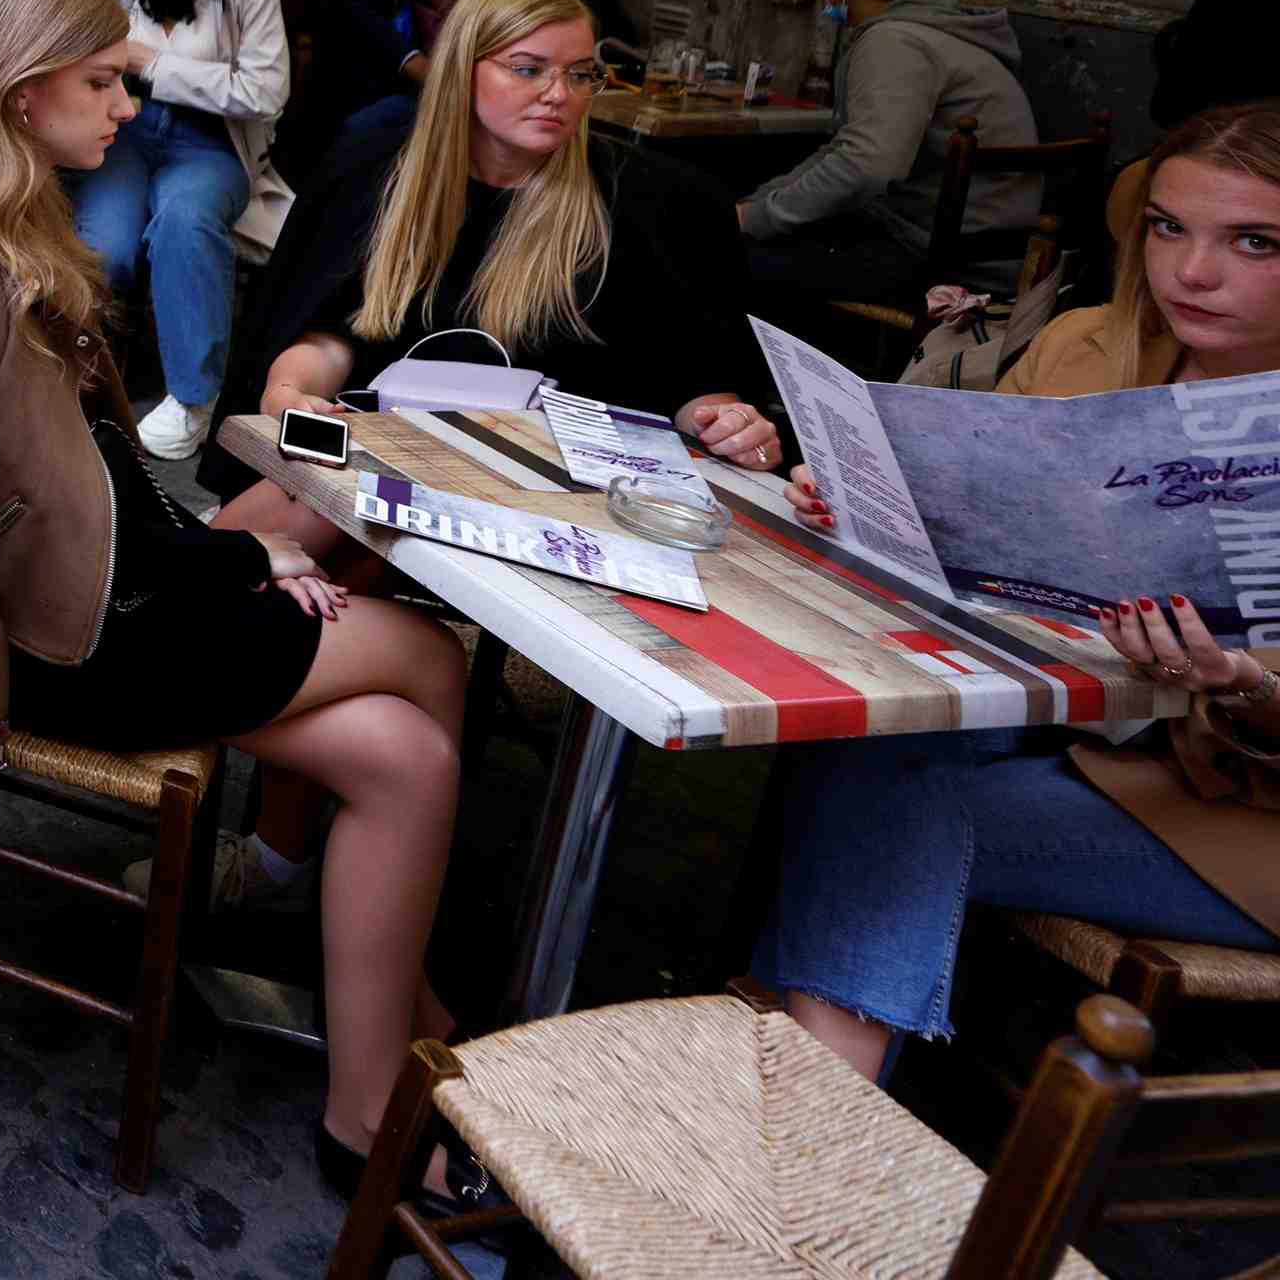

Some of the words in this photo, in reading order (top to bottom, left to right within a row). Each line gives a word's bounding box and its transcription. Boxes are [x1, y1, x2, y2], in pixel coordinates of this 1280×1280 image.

[1103, 466, 1149, 488] La
[1156, 485, 1254, 507] Sons
[355, 492, 545, 566] DRINK
